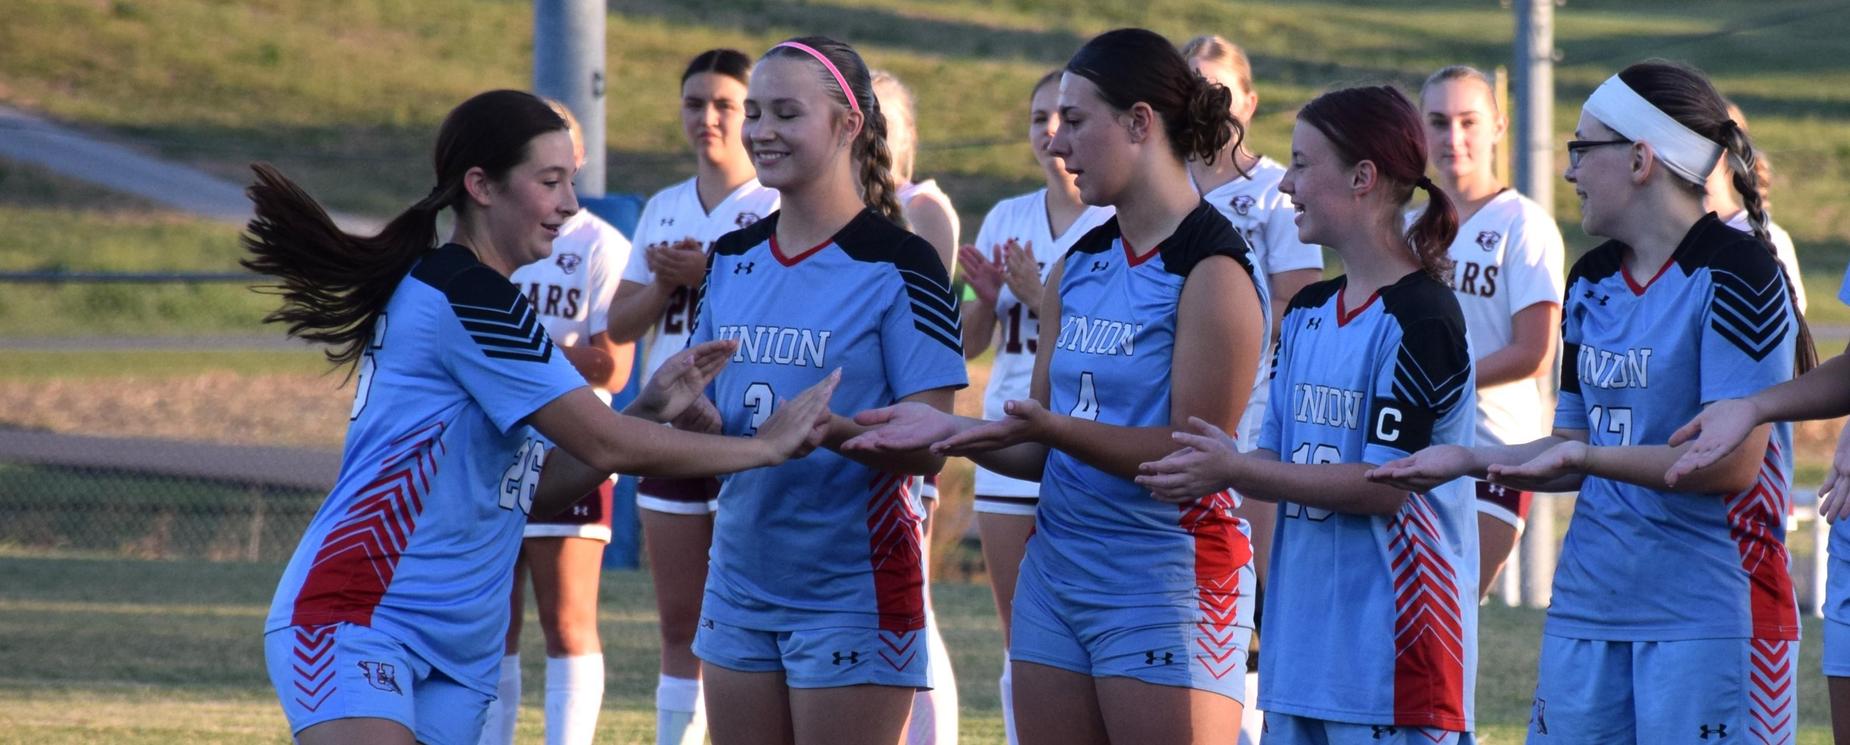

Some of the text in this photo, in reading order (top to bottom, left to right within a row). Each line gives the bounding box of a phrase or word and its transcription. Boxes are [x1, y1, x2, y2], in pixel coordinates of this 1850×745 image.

[511, 283, 582, 320] ARS
[743, 382, 775, 438] 3
[1069, 371, 1100, 421] 4
[1376, 406, 1403, 442] C
[498, 436, 545, 517] 26
